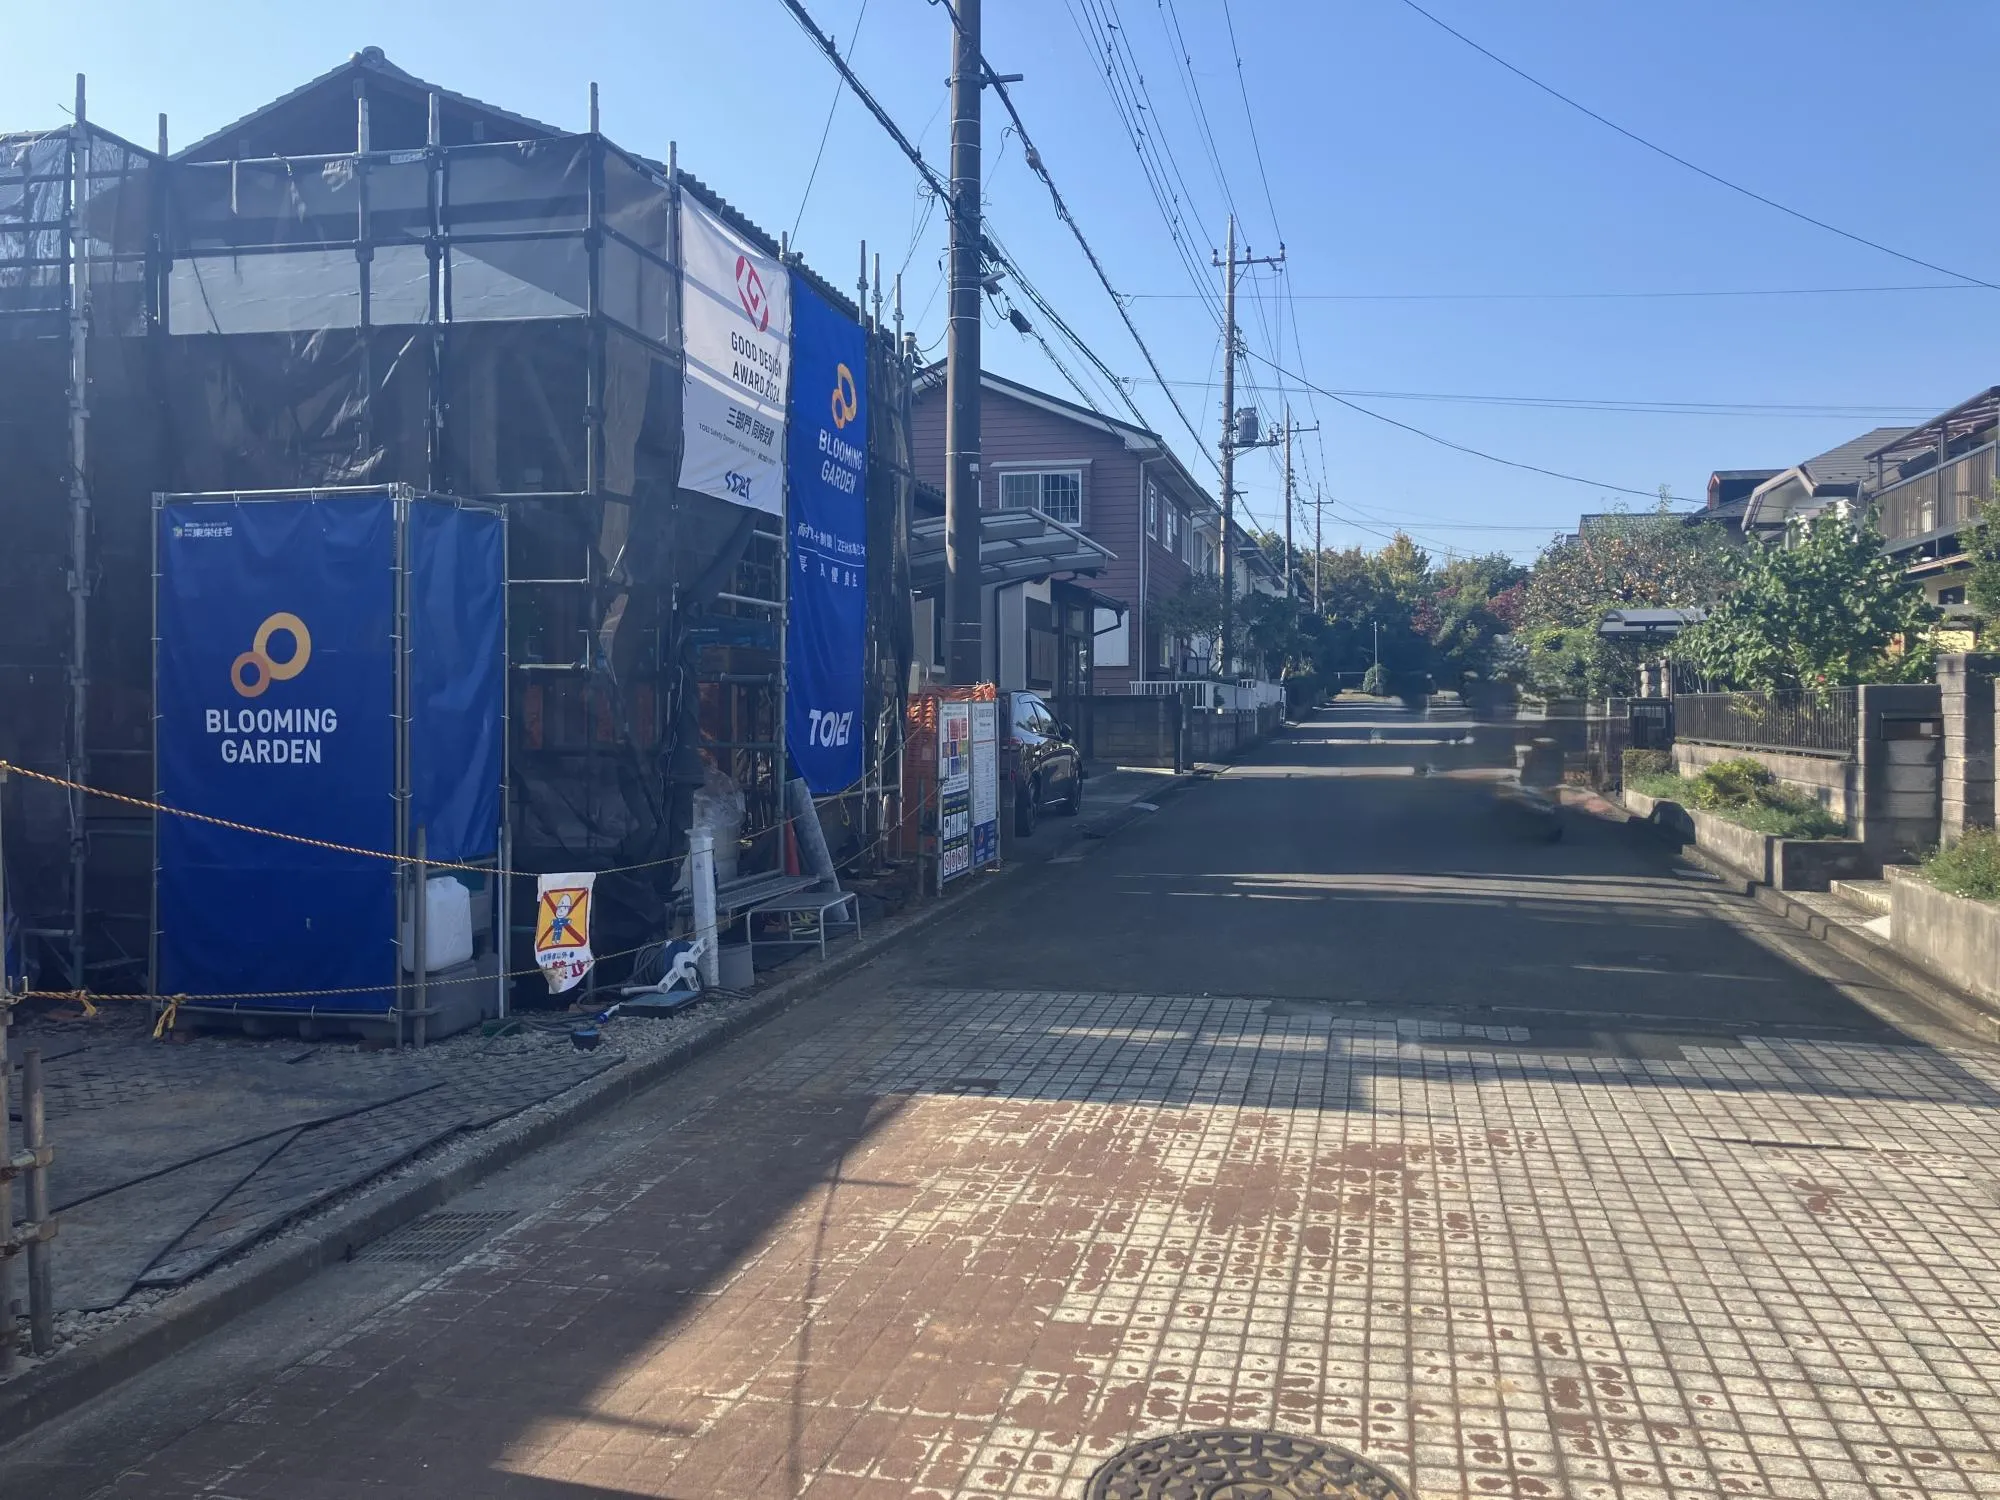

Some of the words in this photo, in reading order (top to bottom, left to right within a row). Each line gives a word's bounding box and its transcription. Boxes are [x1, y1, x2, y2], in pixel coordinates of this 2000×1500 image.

[731, 331, 758, 362] GOOD
[759, 348, 782, 379] DESIGN
[732, 361, 765, 394] AWARD
[819, 428, 863, 471] BLOOMING
[821, 459, 857, 495] GARDEN
[205, 708, 338, 733] BLOOMING
[808, 708, 854, 748] TOEI
[221, 739, 321, 764] GARDEN
